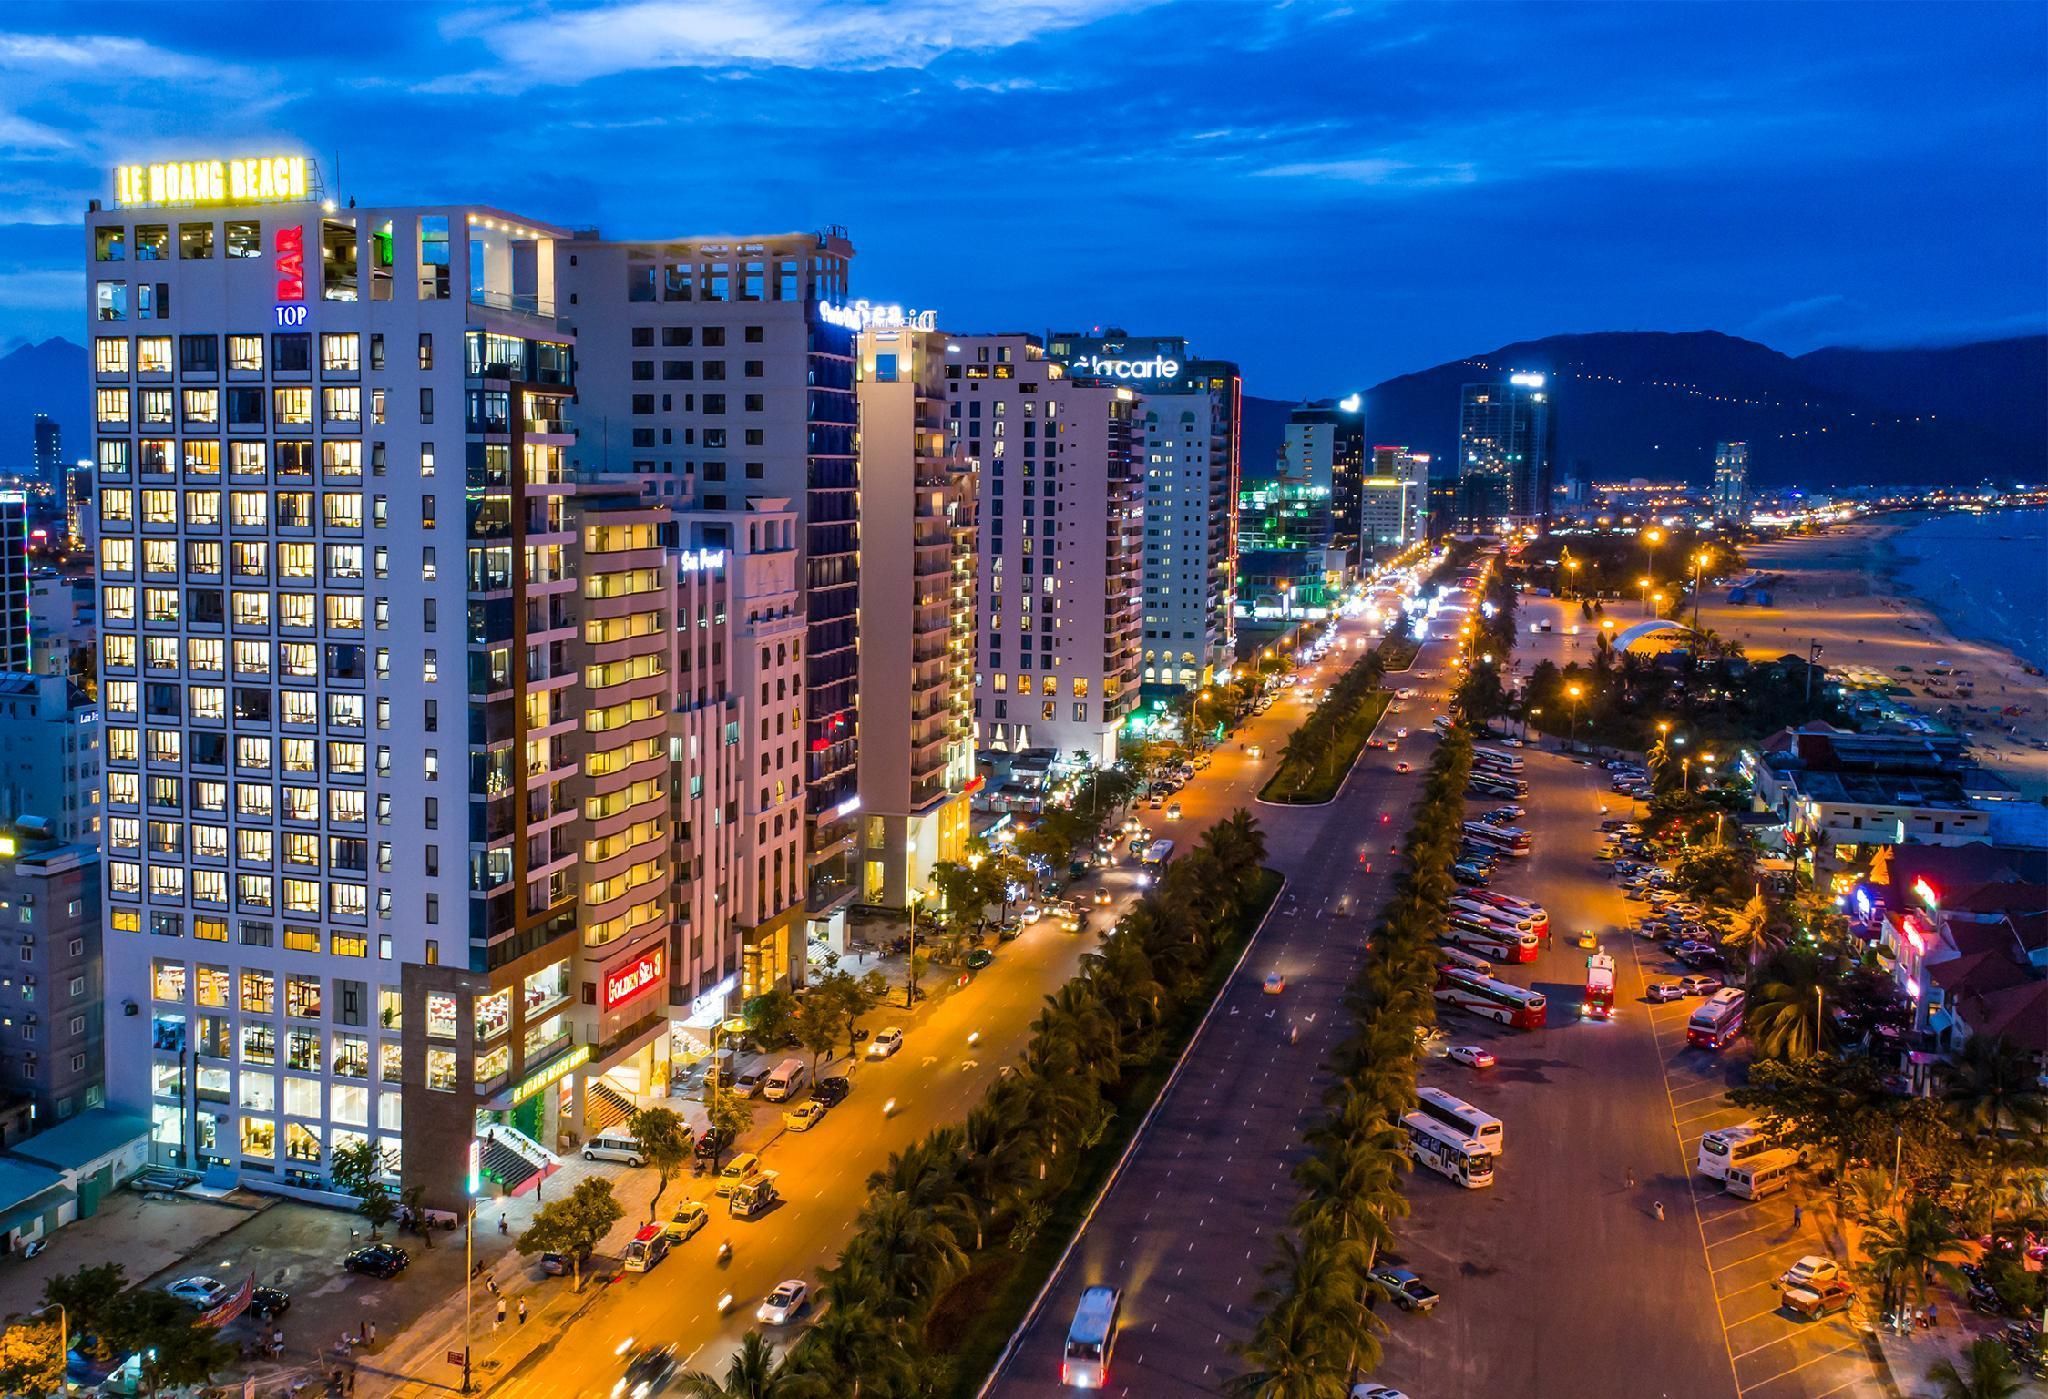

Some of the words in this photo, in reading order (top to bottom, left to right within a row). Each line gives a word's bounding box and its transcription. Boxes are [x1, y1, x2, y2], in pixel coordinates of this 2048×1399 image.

[120, 166, 142, 203] LE
[150, 161, 224, 201] HOANG
[231, 156, 305, 199] BEACH
[275, 224, 303, 301] BAR
[276, 306, 308, 326] TOP
[1115, 354, 1179, 378] carte
